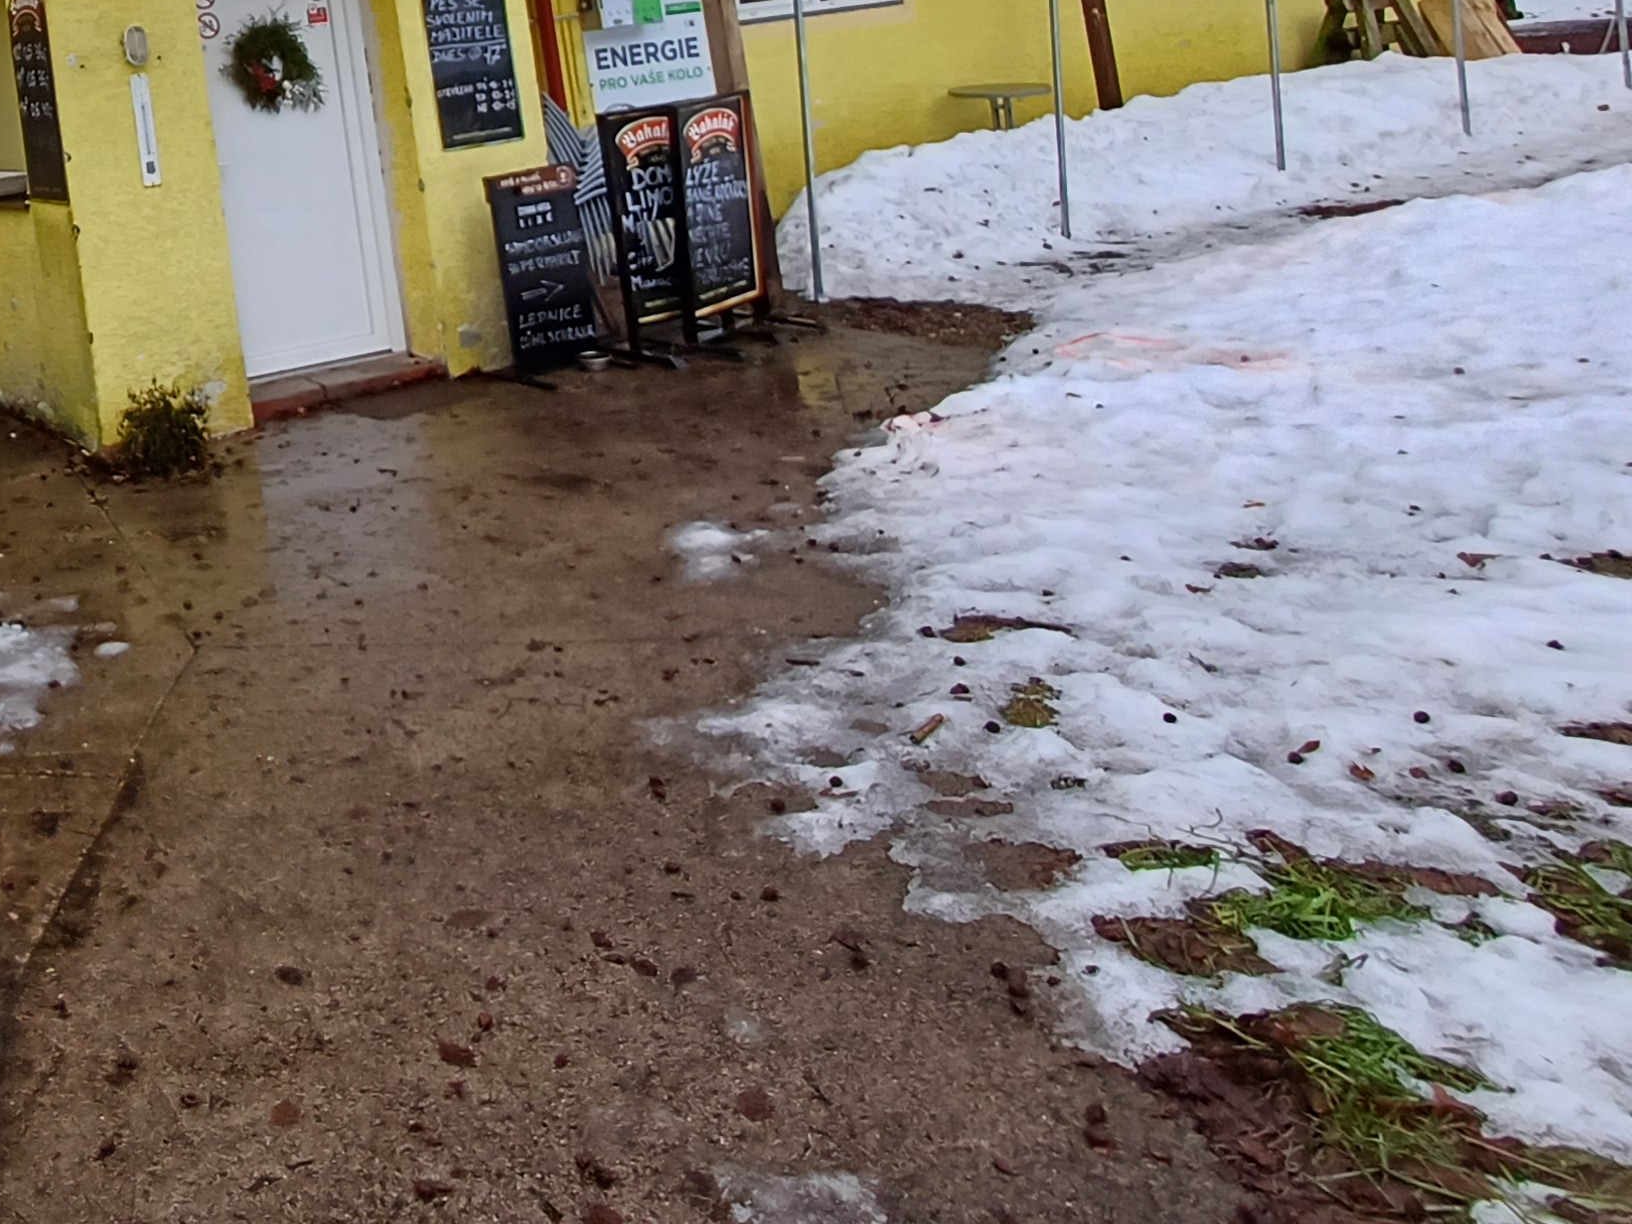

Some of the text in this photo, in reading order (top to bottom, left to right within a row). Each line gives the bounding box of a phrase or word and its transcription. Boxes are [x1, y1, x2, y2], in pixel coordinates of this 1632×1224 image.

[594, 36, 700, 71] ENERGIE
[599, 66, 704, 91] PRO VAŠE KOLO
[519, 304, 582, 329] LEDNICE
